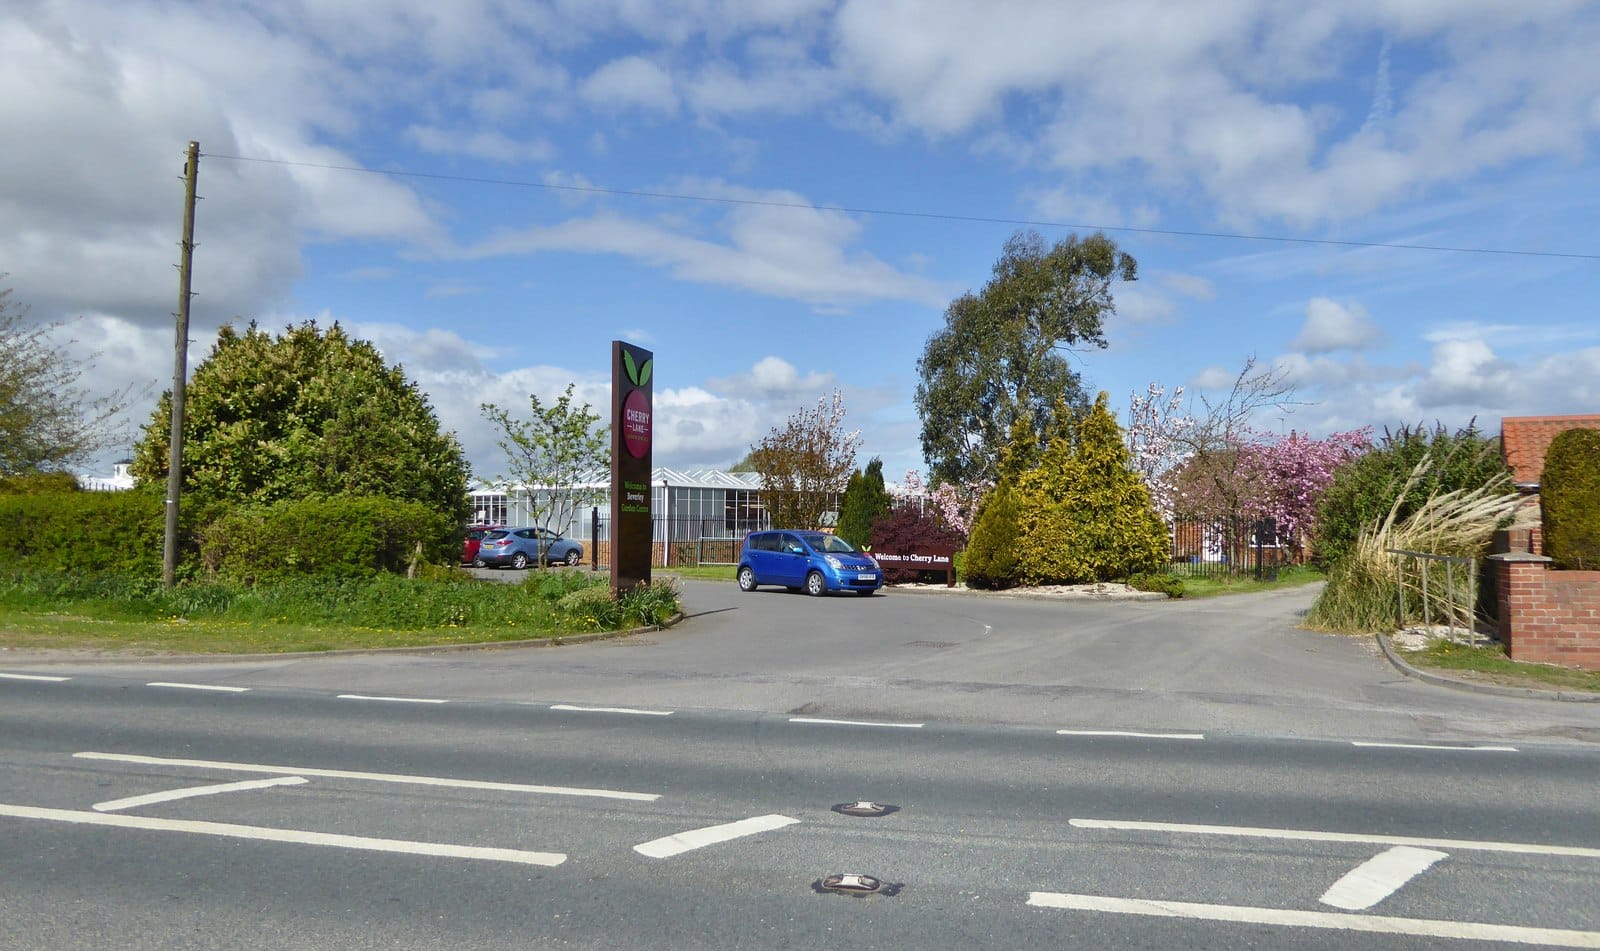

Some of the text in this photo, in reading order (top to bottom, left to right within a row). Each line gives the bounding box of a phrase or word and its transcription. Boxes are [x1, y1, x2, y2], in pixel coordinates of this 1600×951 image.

[626, 408, 650, 424] CHERRY
[632, 424, 644, 433] LANE
[626, 491, 645, 503] Beverley
[875, 553, 902, 561] Welcome
[910, 553, 932, 564] Cherry
[933, 554, 949, 563] Lane
